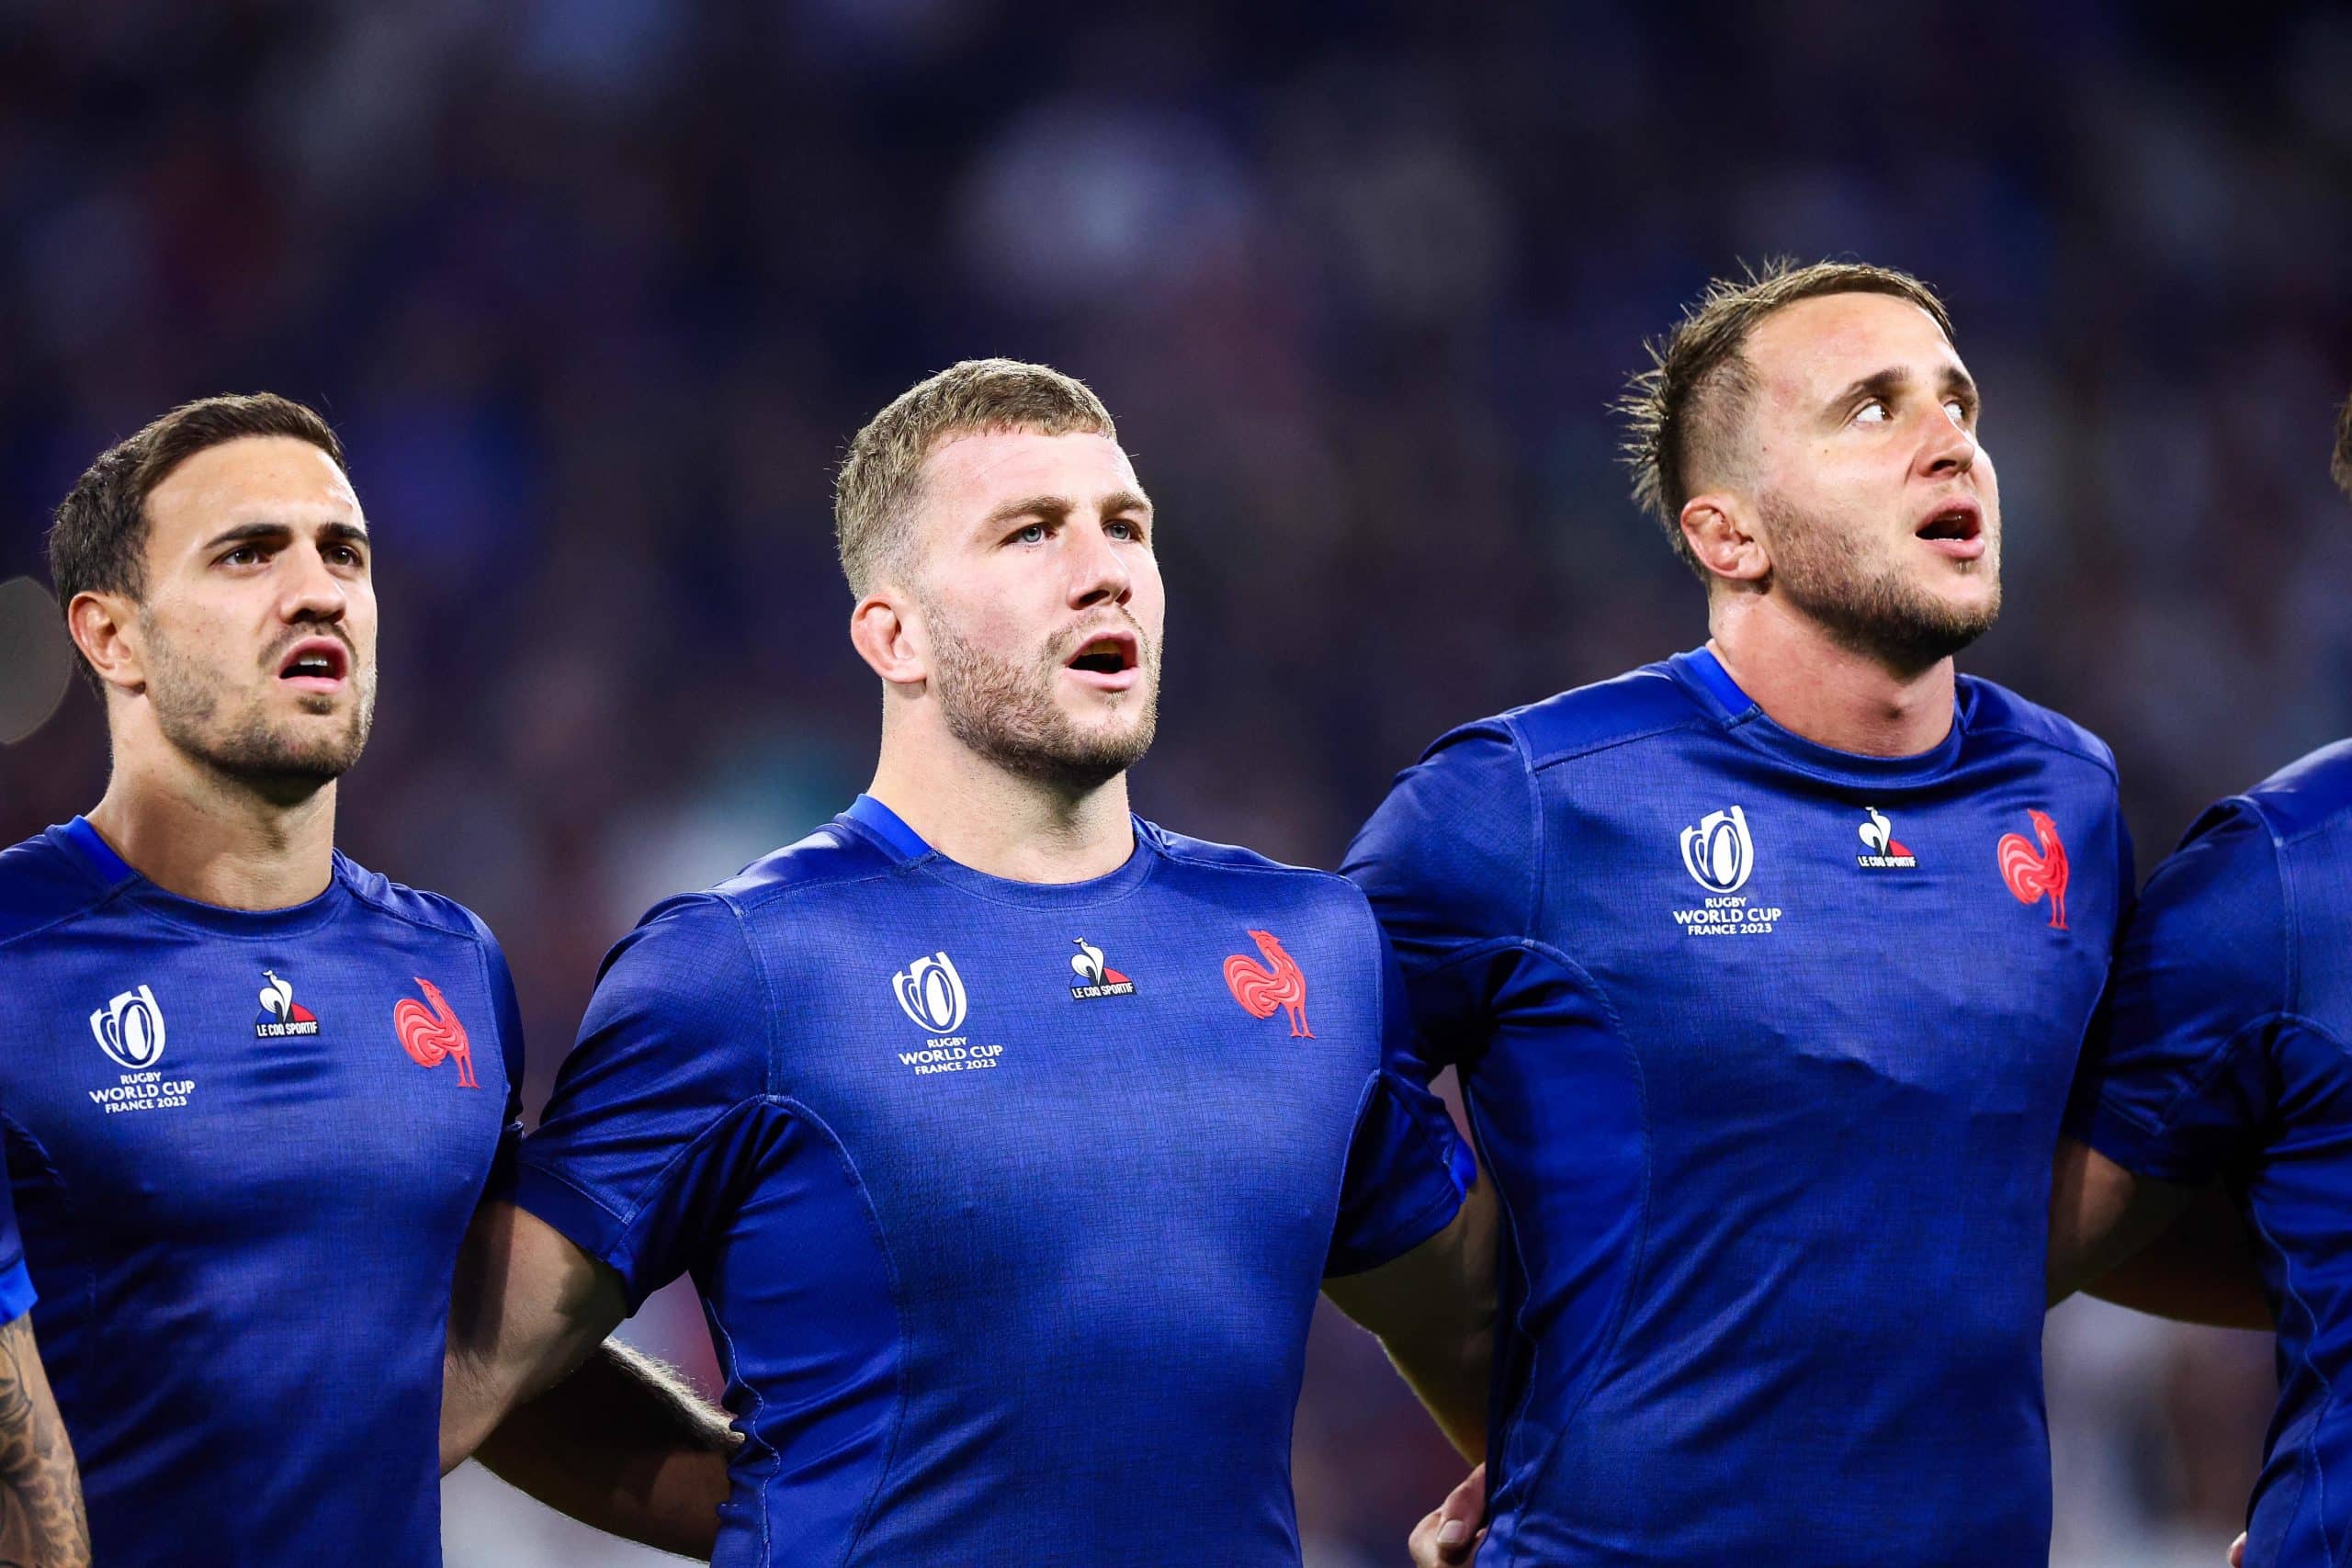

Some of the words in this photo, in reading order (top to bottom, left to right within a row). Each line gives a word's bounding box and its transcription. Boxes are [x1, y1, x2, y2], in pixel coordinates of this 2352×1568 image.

[1858, 856, 1870, 866] LE
[1704, 897, 1747, 908] RUGBY
[1673, 908, 1744, 924] WORLD
[1747, 908, 1781, 921] CUP
[1688, 924, 1737, 935] FRANCE
[1740, 922, 1772, 933] 2023
[1071, 987, 1084, 998] LE
[1083, 986, 1102, 997] COQ
[1100, 982, 1133, 996] SPORTIF
[256, 1024, 267, 1036] LE
[267, 1023, 285, 1036] COQ
[285, 1021, 317, 1035] SPORTIF
[926, 1036, 967, 1048] RUGBY
[898, 1047, 967, 1065] WORLD
[969, 1044, 1003, 1058] CUP
[914, 1062, 963, 1075] FRANCE
[966, 1058, 997, 1070] 2023
[119, 1072, 161, 1085] RUGBY
[88, 1084, 159, 1103] WORLD
[162, 1080, 195, 1095] CUP
[105, 1099, 154, 1113] FRANCE
[157, 1096, 187, 1108] 2023
